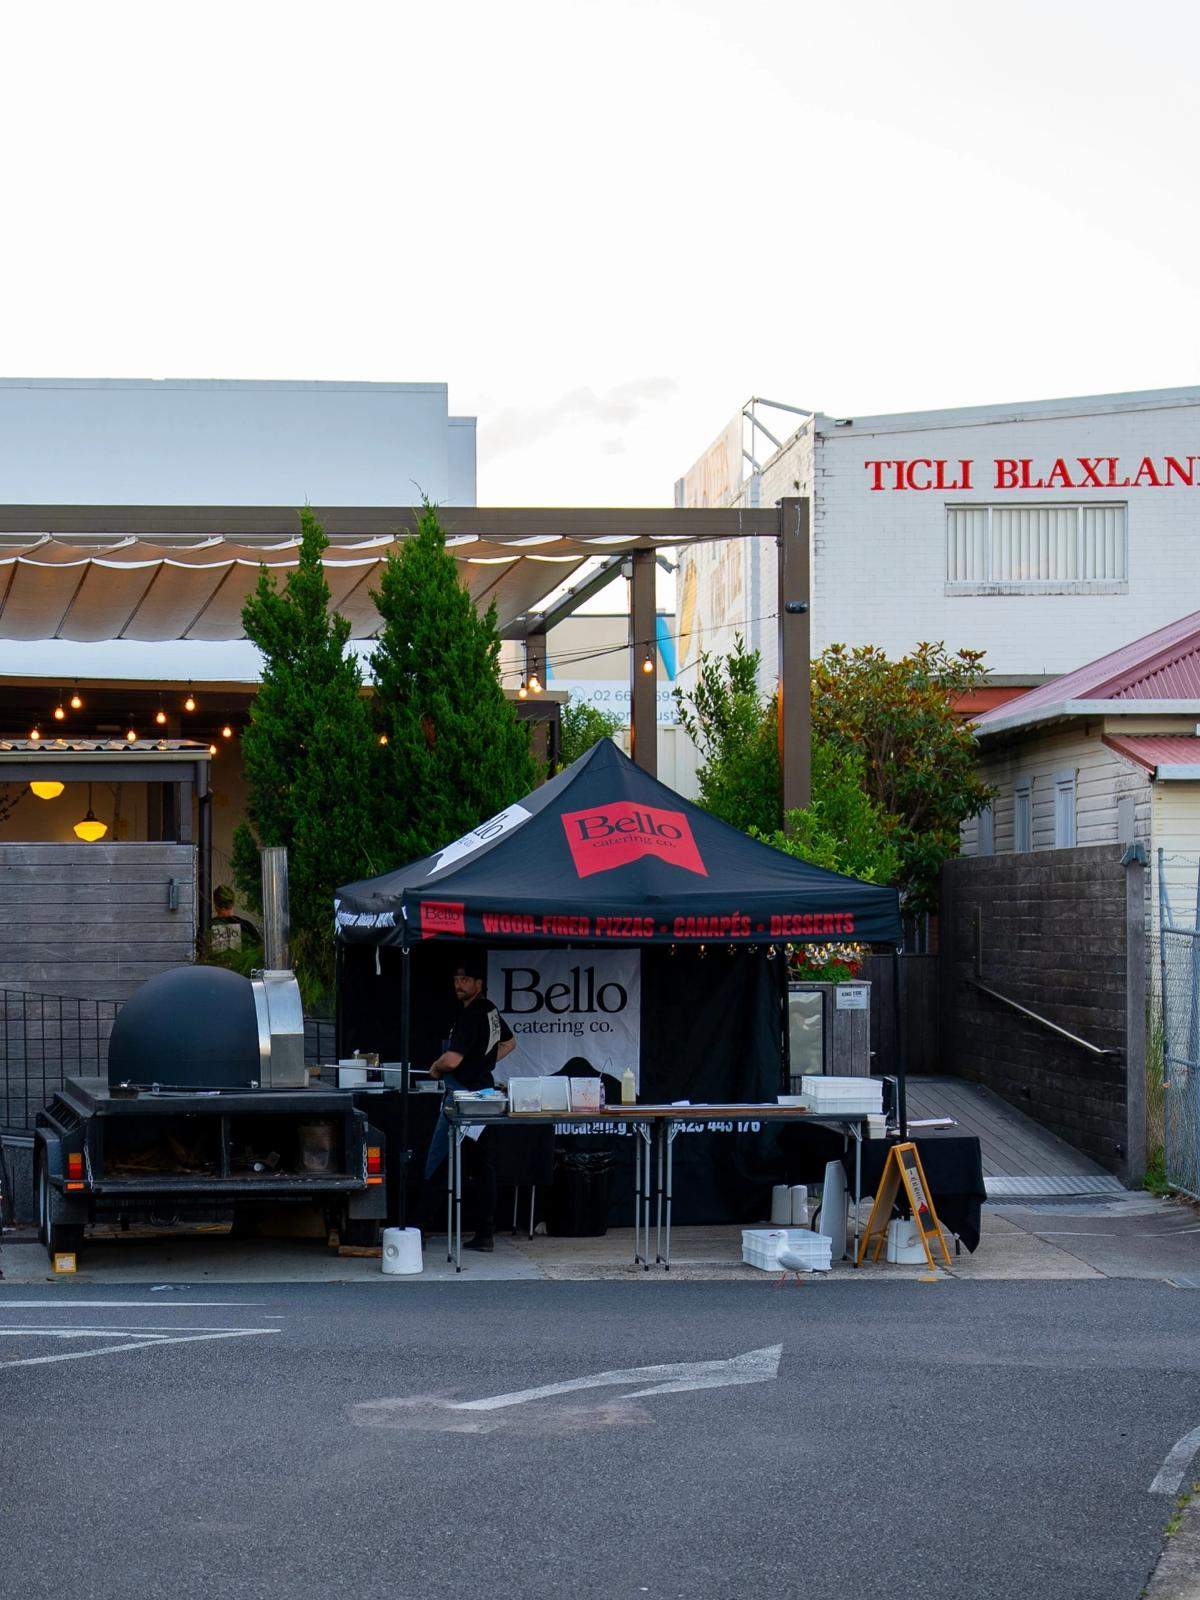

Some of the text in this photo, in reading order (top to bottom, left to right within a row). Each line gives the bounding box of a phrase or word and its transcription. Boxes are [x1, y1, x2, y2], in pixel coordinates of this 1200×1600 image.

[864, 456, 1200, 490] TICLI BLAXLAN
[575, 811, 682, 840] Bello
[593, 835, 652, 849] catering
[426, 907, 460, 920] Bello
[483, 911, 855, 937] WOOD-FIRED PIZZAS CANAPÉS DESSERTS
[500, 966, 627, 1014] Bello
[513, 1018, 584, 1037] catering
[590, 1021, 614, 1033] co.
